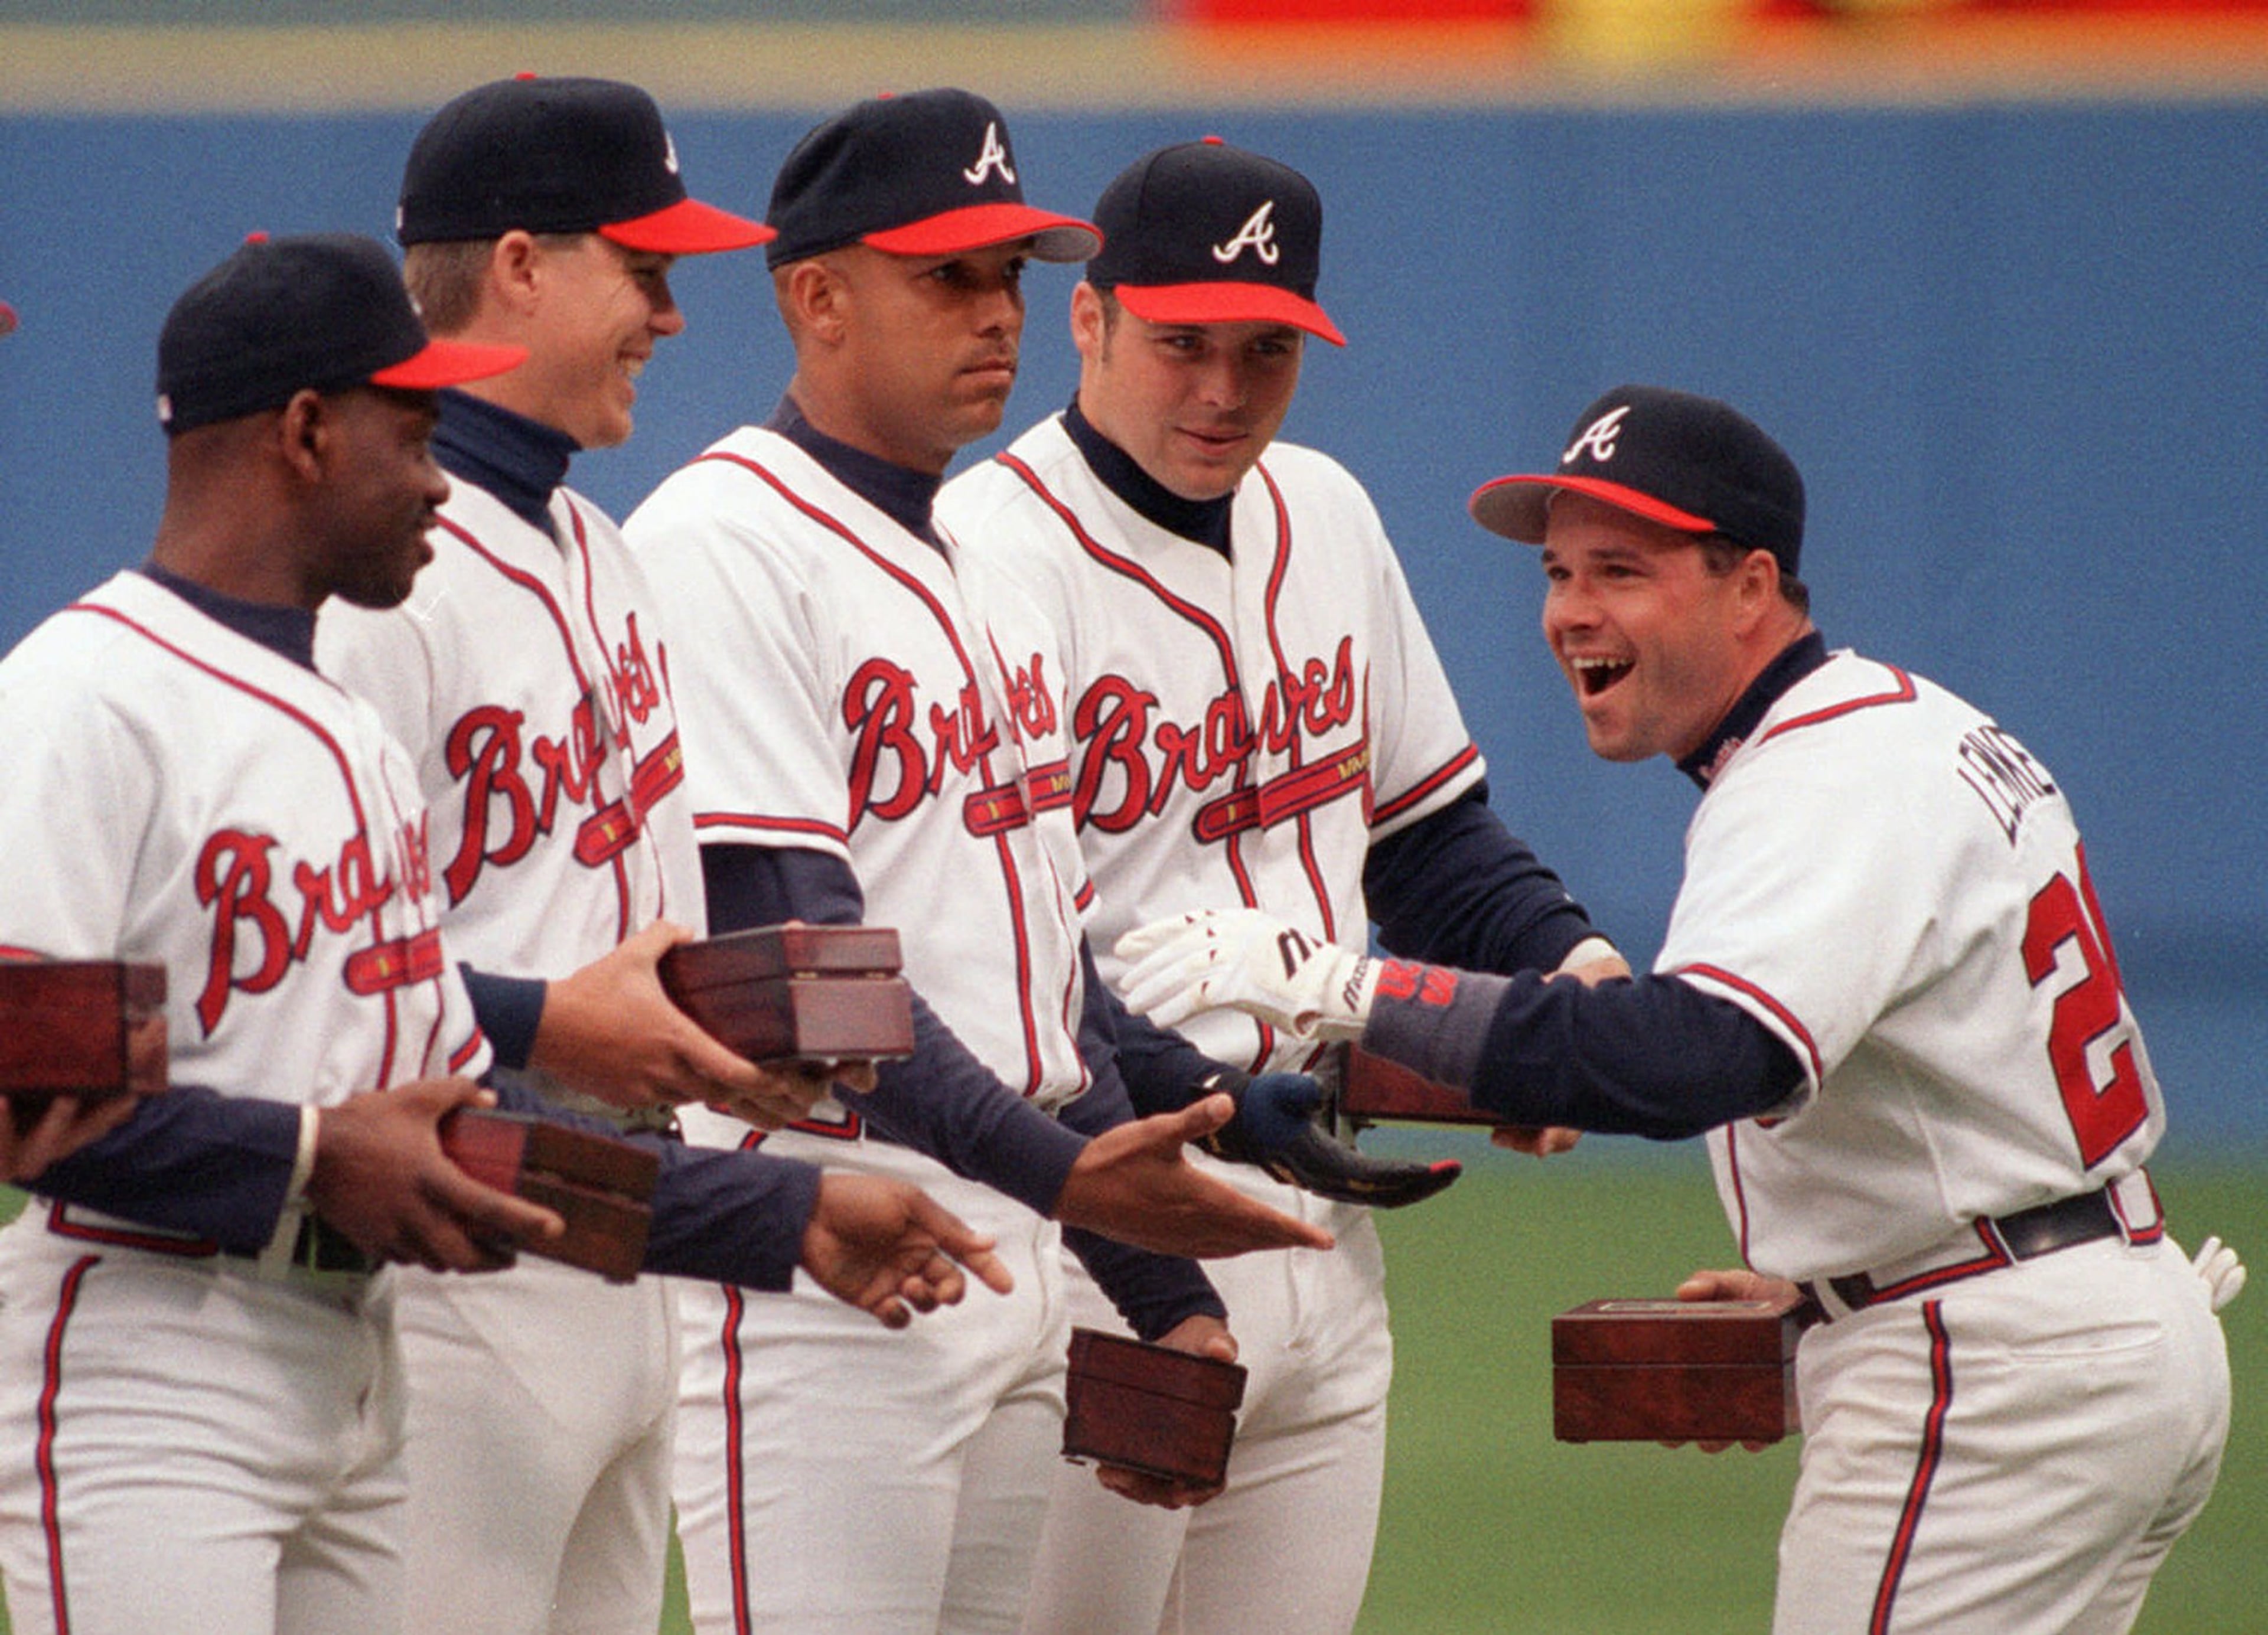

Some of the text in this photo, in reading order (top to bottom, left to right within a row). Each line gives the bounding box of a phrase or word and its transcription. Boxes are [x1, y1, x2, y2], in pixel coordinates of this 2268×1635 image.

[963, 121, 1015, 185] A
[1212, 199, 1279, 265] A
[1562, 405, 1631, 464] A
[1073, 635, 1354, 836] Braves
[2021, 838, 2149, 1171] 2
